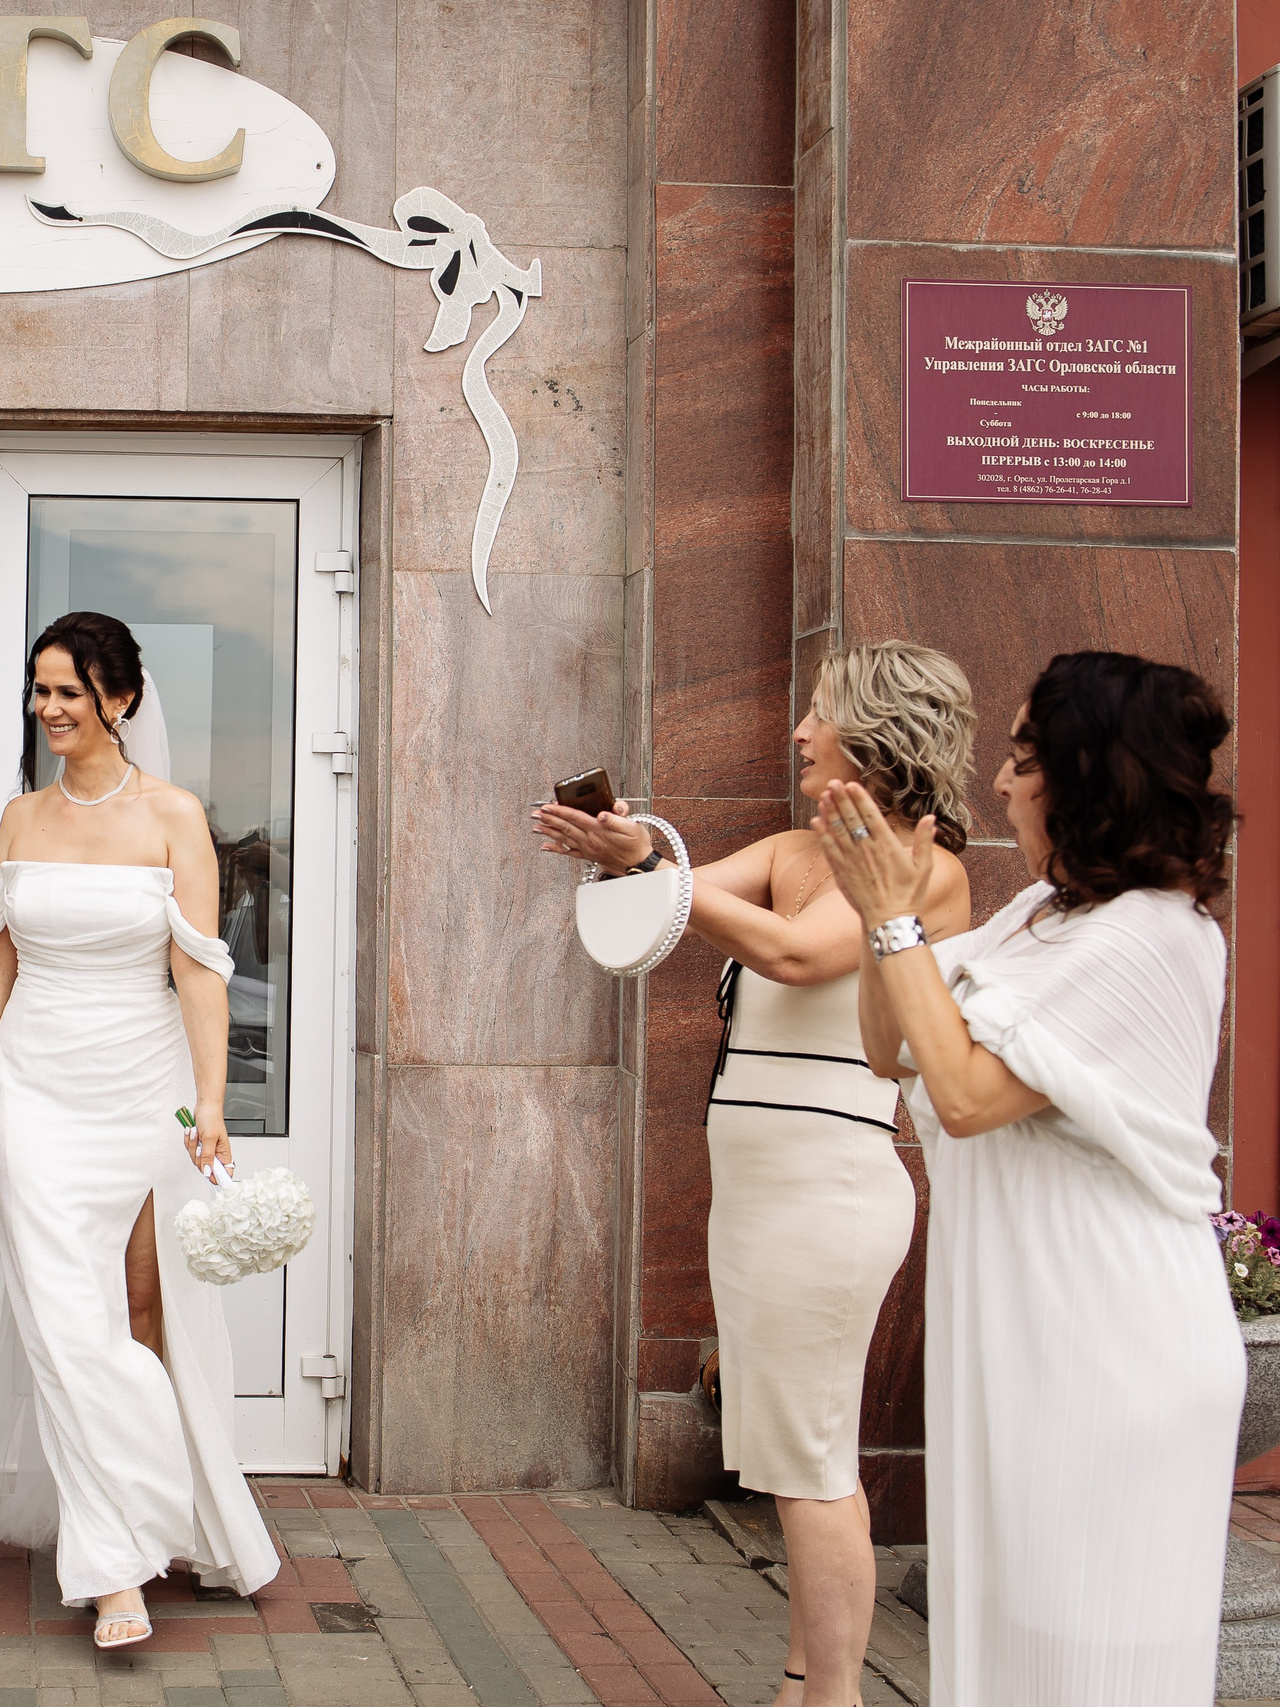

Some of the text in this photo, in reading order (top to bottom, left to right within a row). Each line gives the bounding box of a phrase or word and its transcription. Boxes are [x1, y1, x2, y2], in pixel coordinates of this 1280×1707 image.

[944, 337, 1148, 353] Межрайонный отдел ЗАГС №1
[923, 357, 1177, 376] Управления ЗАГС Орловской области
[1050, 385, 1091, 393] РАБОТЫ:
[969, 398, 1023, 406] Понедельник
[979, 419, 1012, 428] Суббота
[946, 435, 1155, 450] ВЫХОДНОЙ ДЕНЬ: ВОСКРЕСЕНЬЕ
[981, 456, 1042, 466] ПЕРЕРЫВ
[1052, 457, 1081, 467] 13:00
[1098, 458, 1127, 468] 14:00
[977, 474, 1006, 482] 302028,
[1049, 476, 1100, 485] Пролетарская
[1101, 477, 1119, 485] Гора
[1019, 486, 1044, 494] (4862)
[1044, 486, 1079, 494] 76-26-41,
